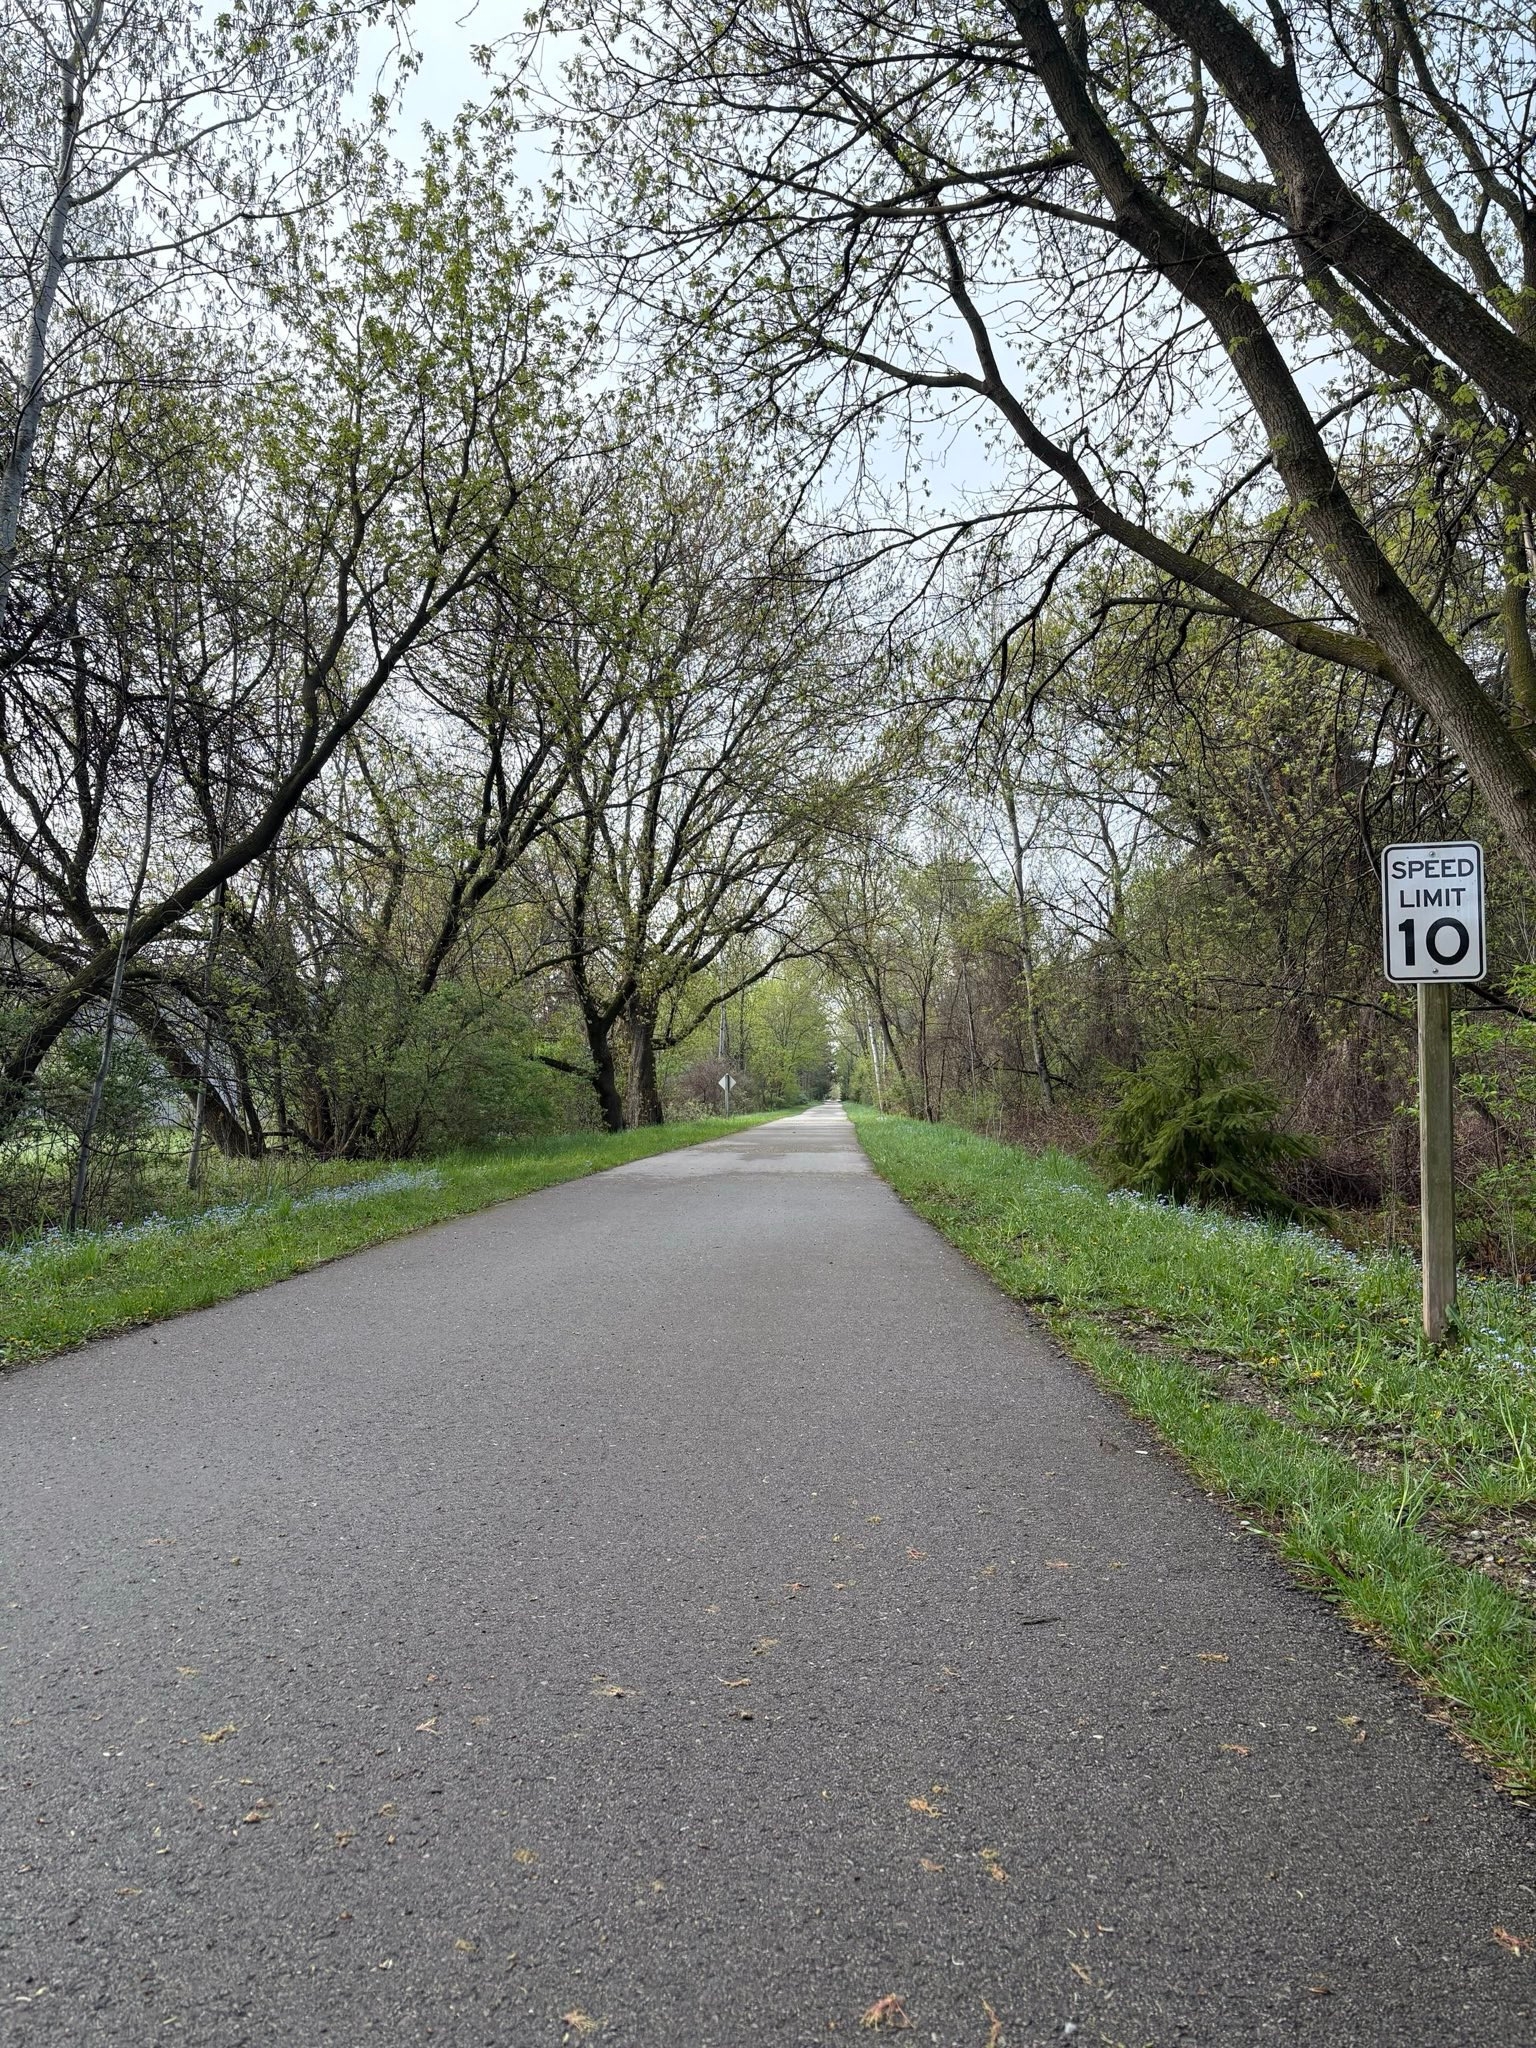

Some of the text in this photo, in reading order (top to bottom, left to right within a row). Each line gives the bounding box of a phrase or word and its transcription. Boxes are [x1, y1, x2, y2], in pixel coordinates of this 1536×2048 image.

[1392, 859, 1474, 879] SPEED
[1400, 888, 1466, 908] LIMIT
[1398, 918, 1470, 966] 10
